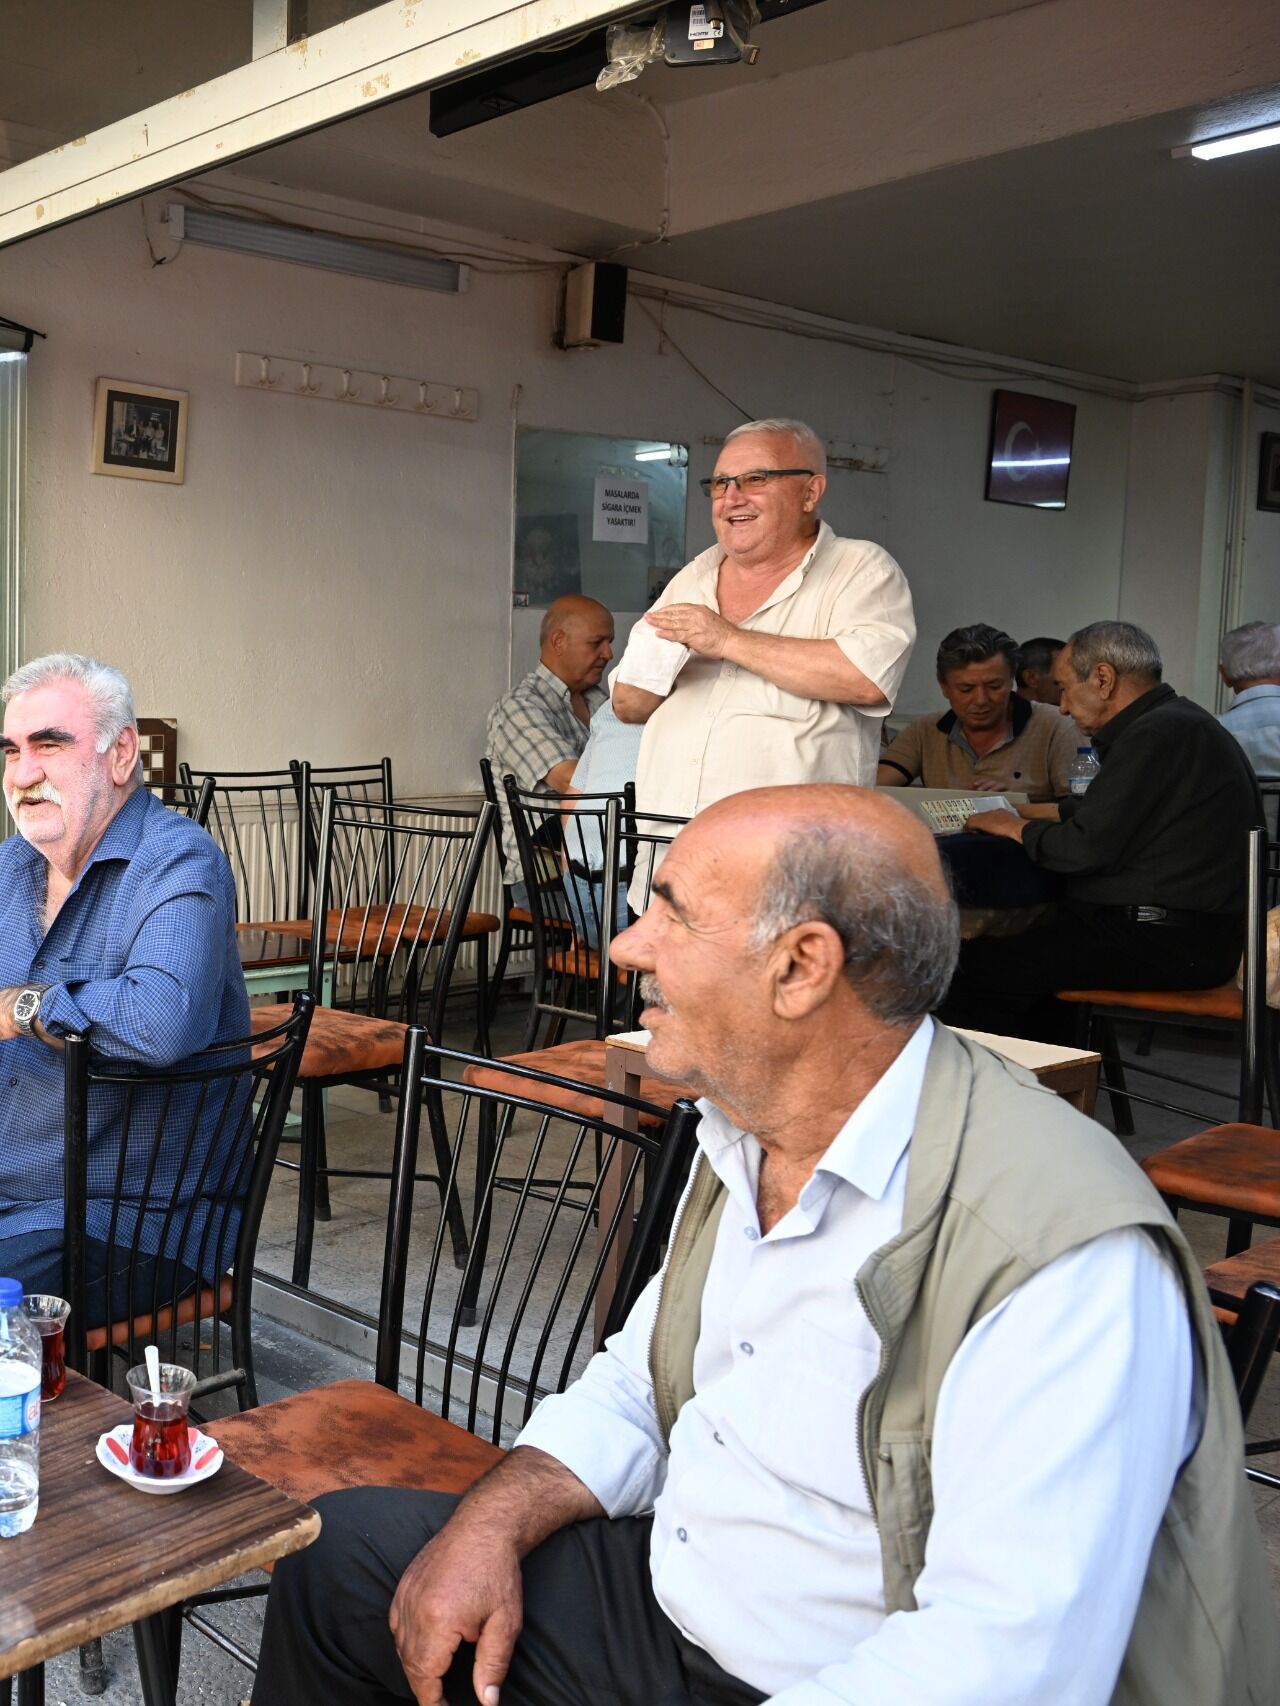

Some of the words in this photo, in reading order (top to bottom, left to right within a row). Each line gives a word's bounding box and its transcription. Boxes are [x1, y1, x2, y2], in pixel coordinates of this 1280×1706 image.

[604, 489, 640, 500] MASALARDA
[601, 502, 622, 512] SİGARA
[623, 503, 642, 514] İÇMEK
[607, 517, 636, 527] YASAKTIR!
